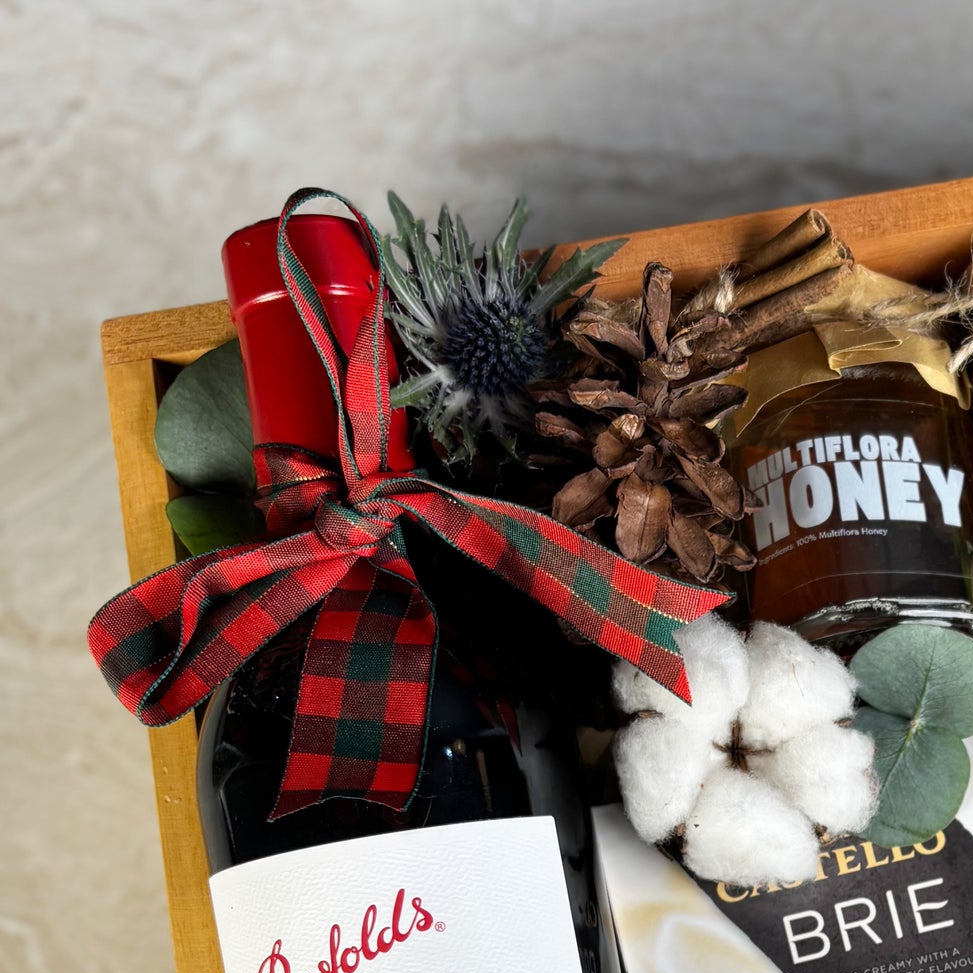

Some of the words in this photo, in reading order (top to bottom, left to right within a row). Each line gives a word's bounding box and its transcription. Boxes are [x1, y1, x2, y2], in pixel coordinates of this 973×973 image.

[747, 434, 922, 492] MULTIFLORA
[750, 460, 965, 551] HONEY
[796, 535, 817, 548] 100%
[819, 528, 859, 540] Multiflora
[861, 527, 888, 536] Honey
[782, 877, 955, 965] BRIE
[916, 950, 949, 964] WITH
[951, 947, 961, 956] A
